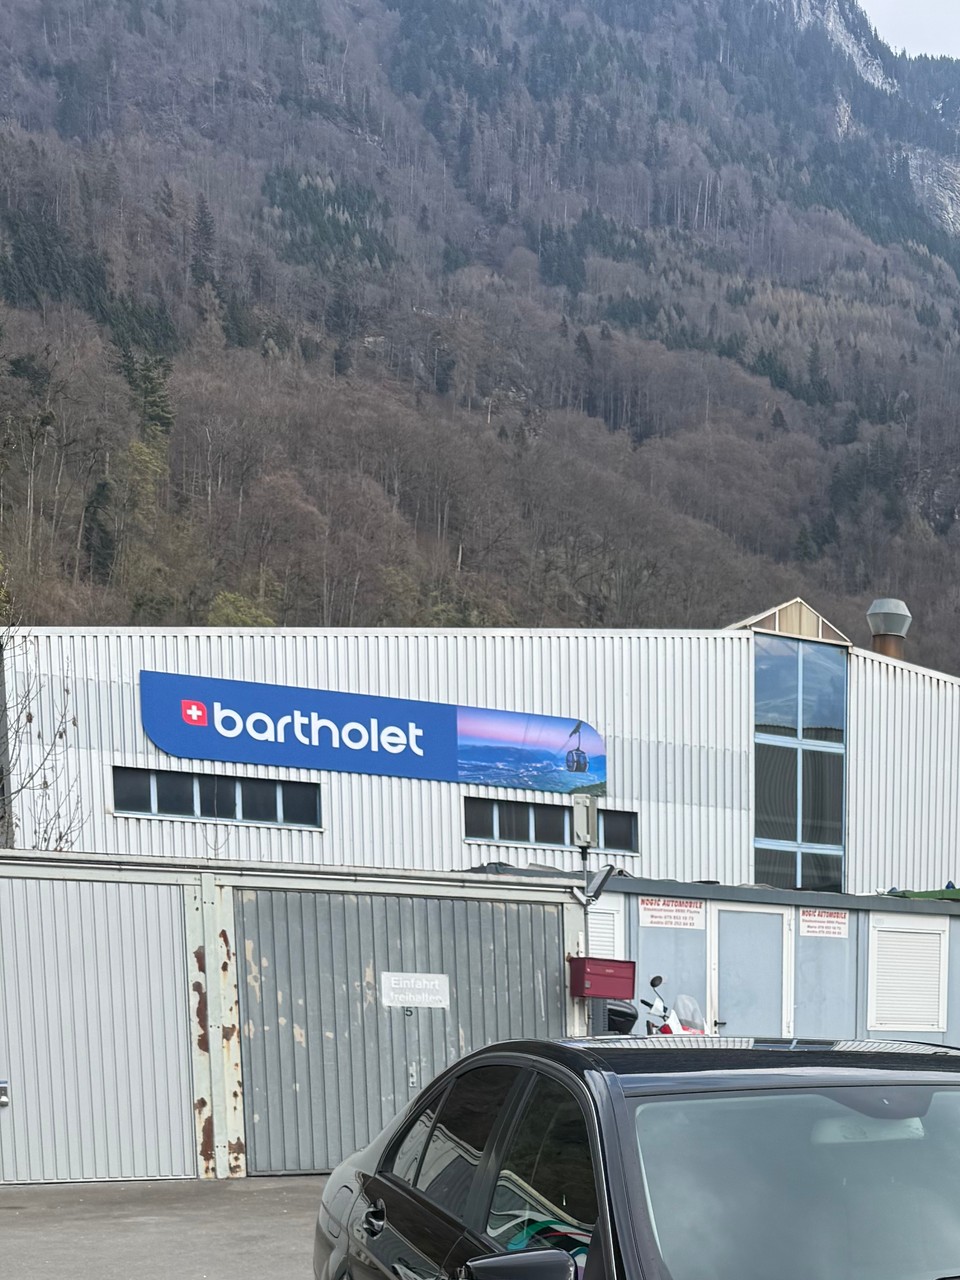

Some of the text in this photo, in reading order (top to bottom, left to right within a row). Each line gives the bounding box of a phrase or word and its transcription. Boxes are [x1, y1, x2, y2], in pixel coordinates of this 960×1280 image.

[213, 702, 424, 756] bartholet
[662, 899, 703, 909] AUTOMOBILE
[391, 976, 440, 989] Einfahrt
